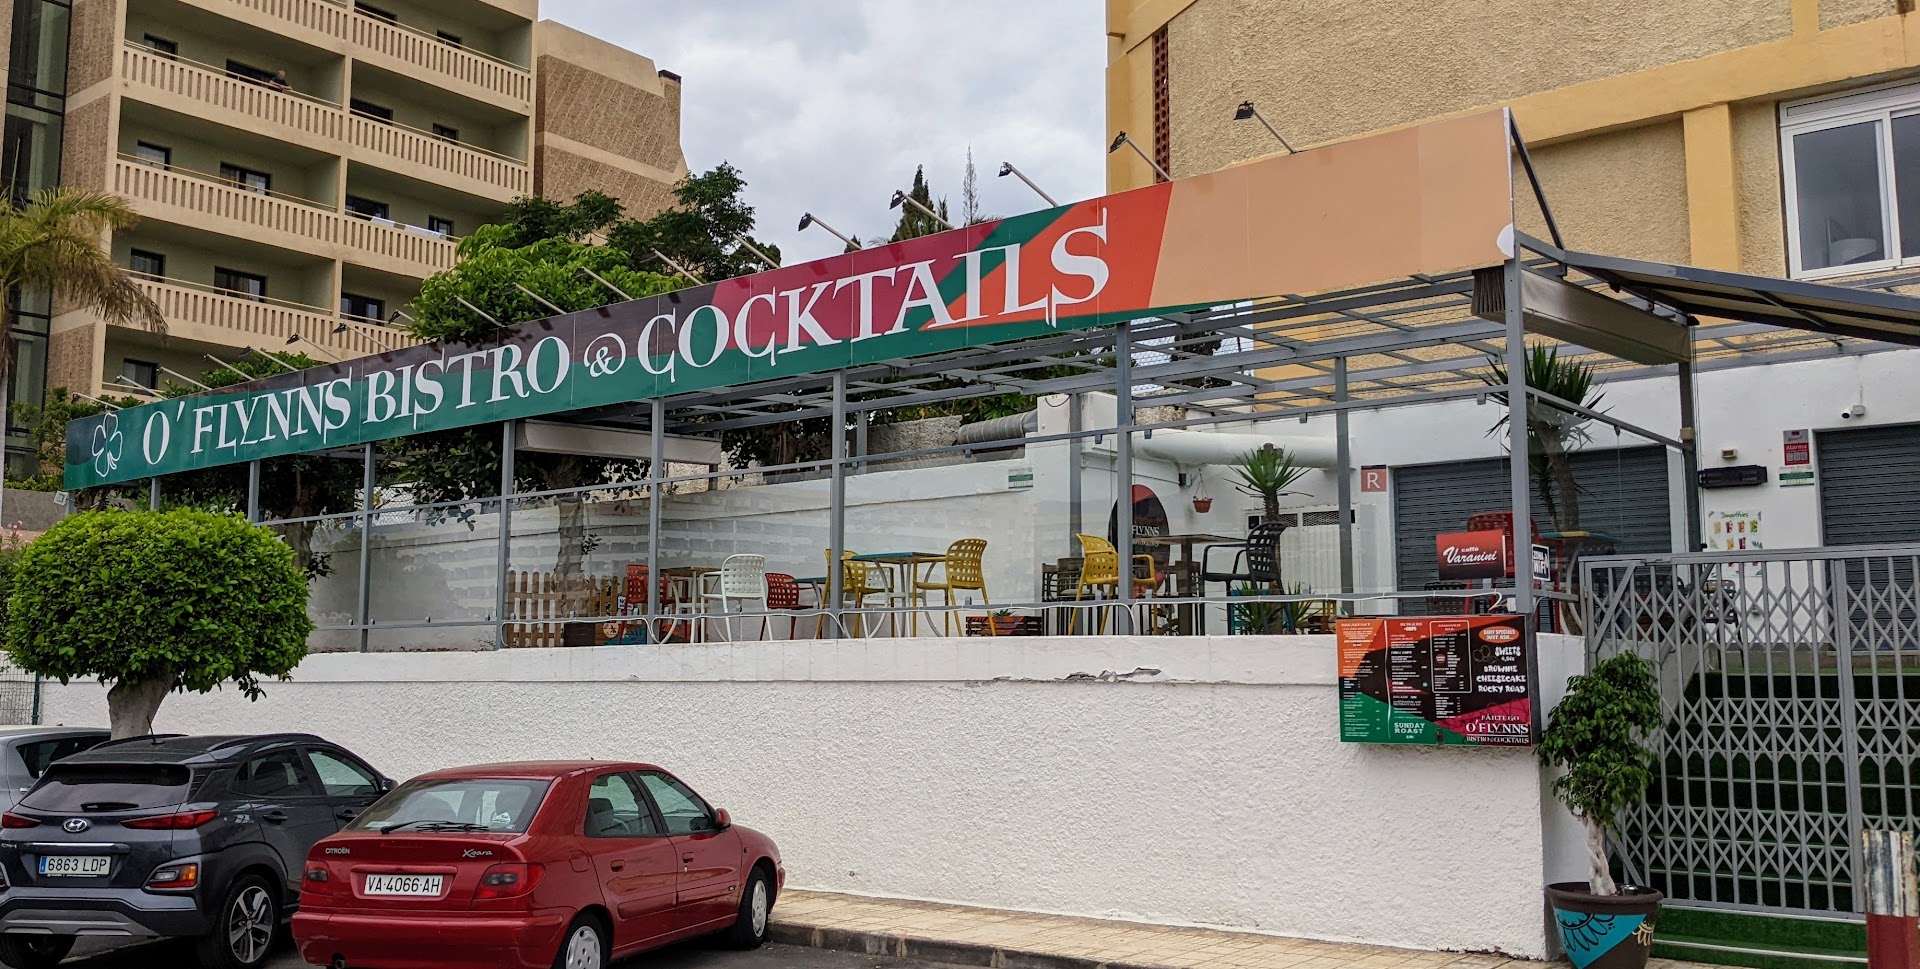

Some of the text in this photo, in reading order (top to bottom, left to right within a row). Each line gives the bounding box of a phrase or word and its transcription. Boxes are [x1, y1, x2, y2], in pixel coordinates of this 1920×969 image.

[362, 336, 571, 430] BISTRO
[583, 332, 627, 378] &
[636, 207, 1110, 383] COCKTAILS
[1367, 472, 1381, 489] R
[1131, 525, 1160, 537] FLYNNS
[1442, 546, 1497, 563] Varanini
[1494, 646, 1521, 657] SWEETS
[1483, 665, 1518, 673] BROWNIE
[1476, 674, 1526, 683] CHEESECAKE
[1478, 685, 1526, 694] ROCKY ROAD
[1465, 719, 1529, 735] O'FLYNNS
[462, 848, 493, 858] Xsara
[48, 858, 107, 872] 6863 LDP
